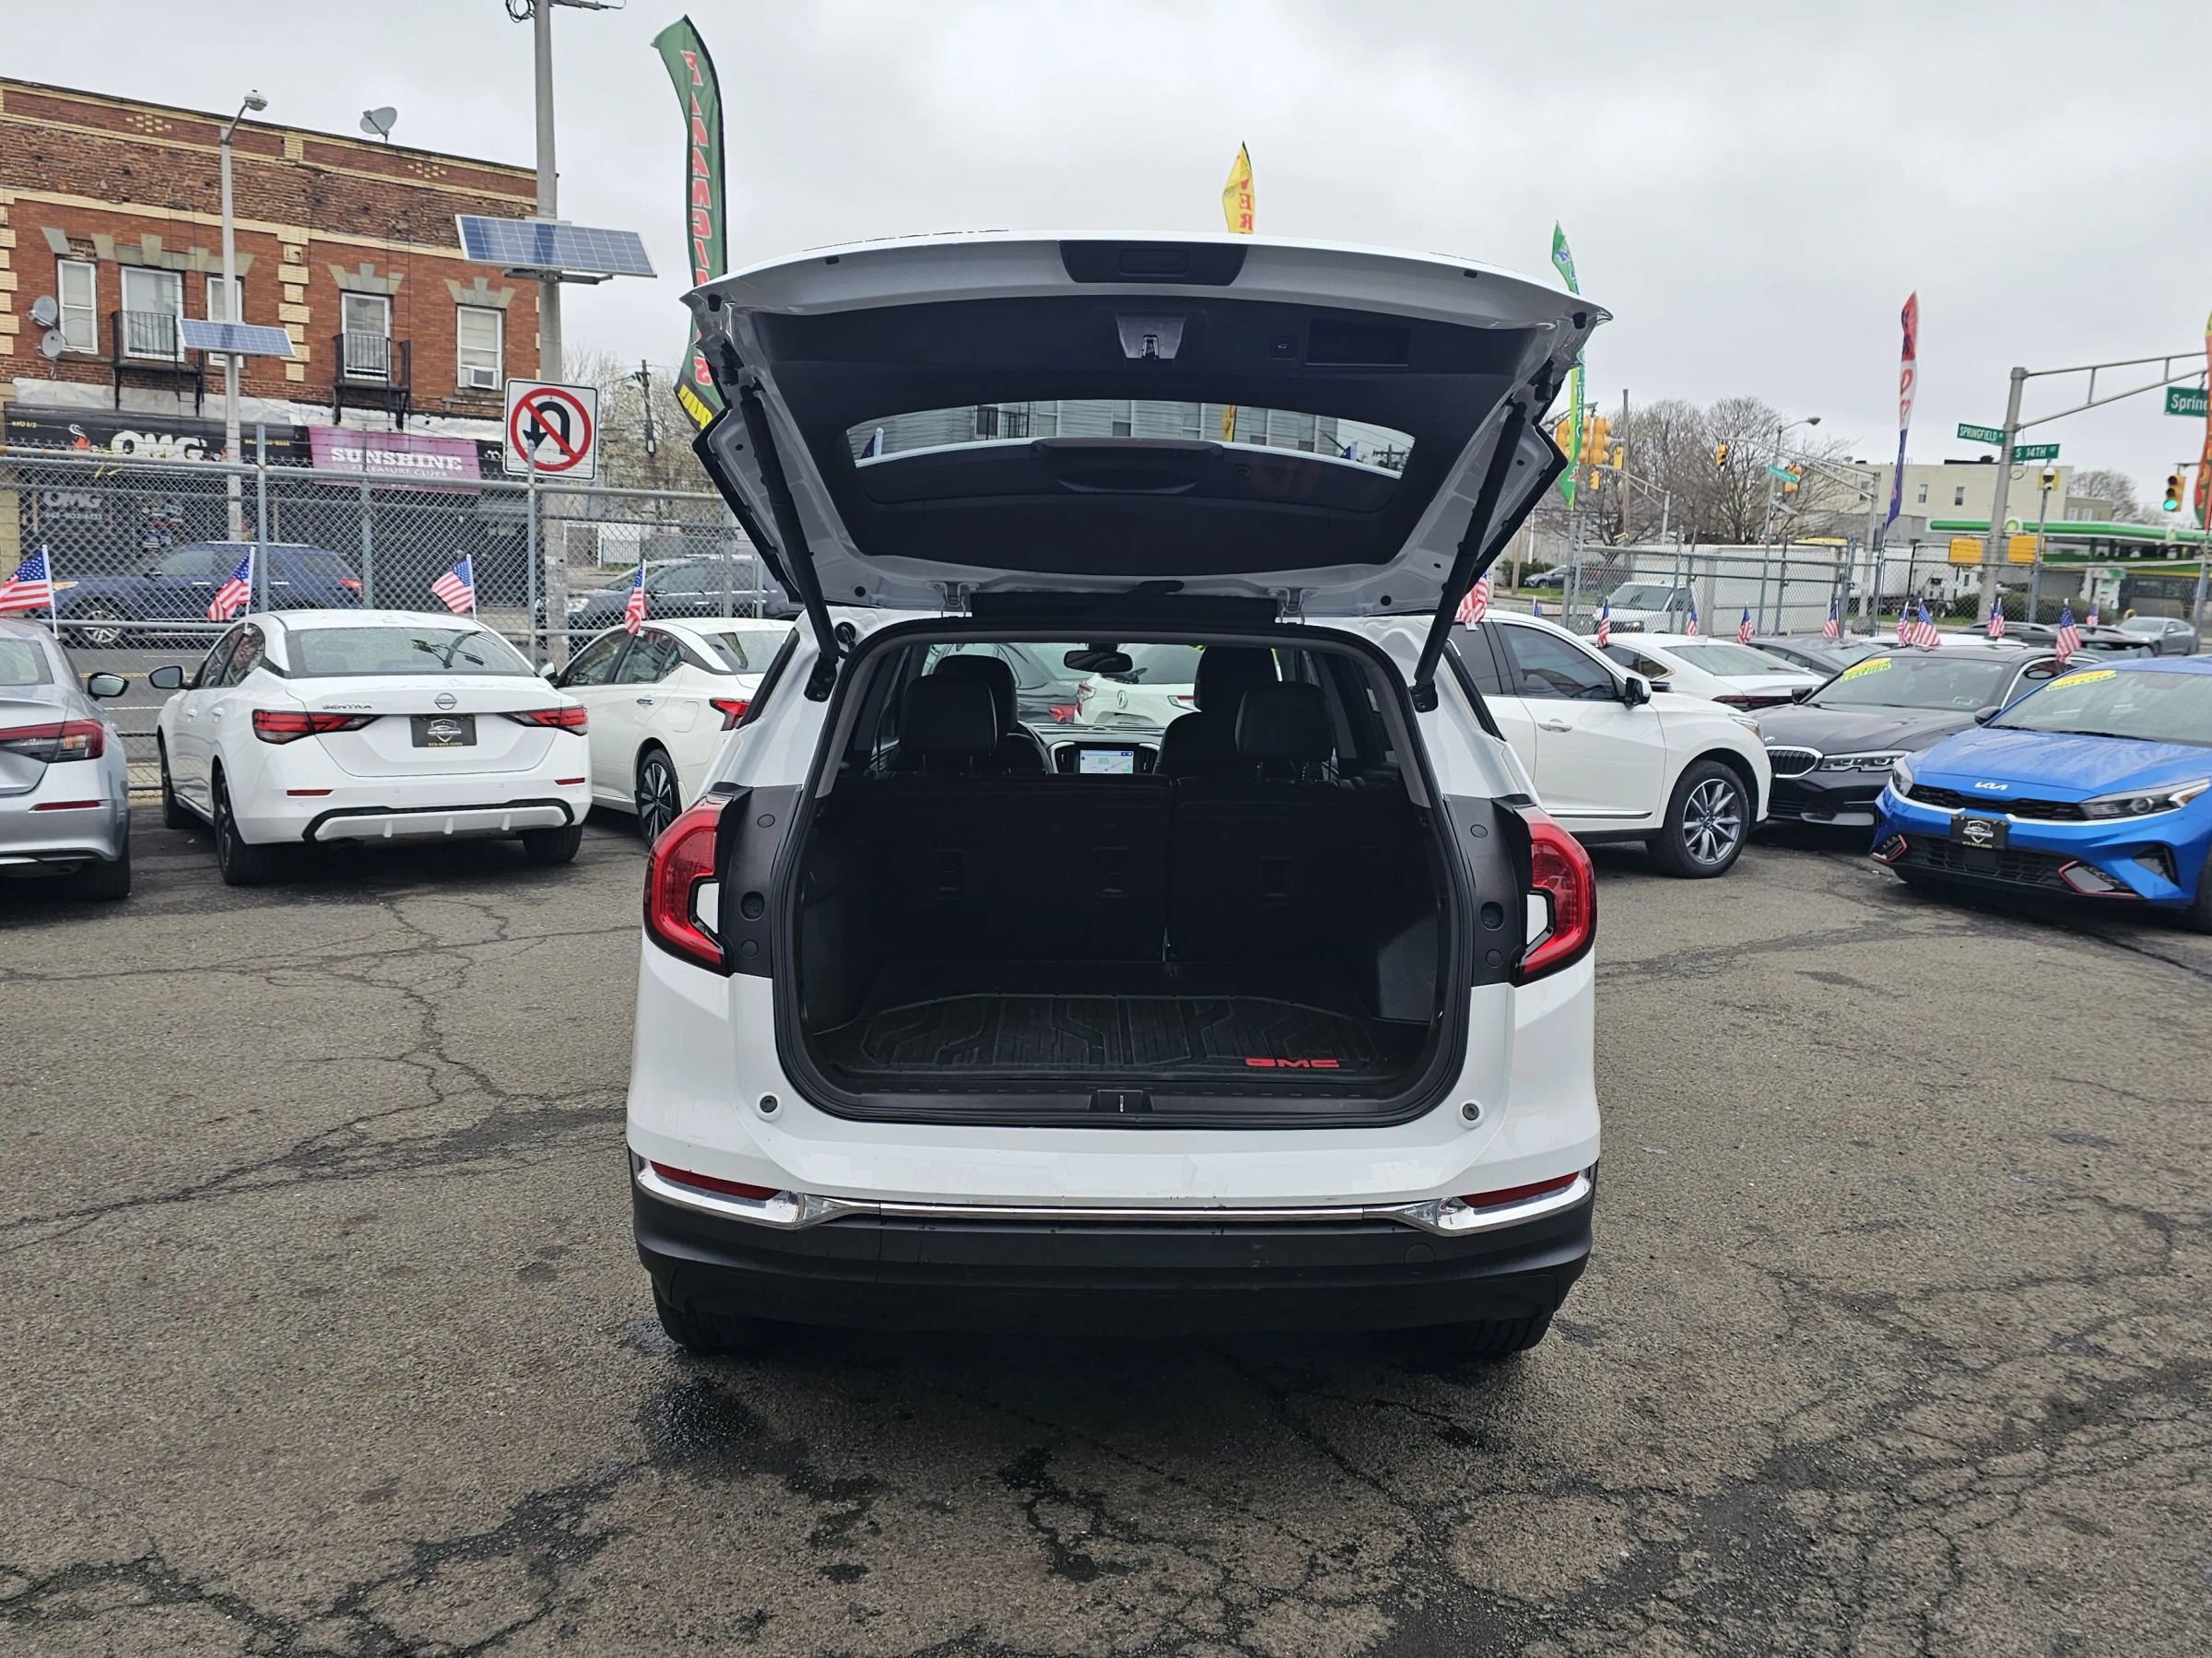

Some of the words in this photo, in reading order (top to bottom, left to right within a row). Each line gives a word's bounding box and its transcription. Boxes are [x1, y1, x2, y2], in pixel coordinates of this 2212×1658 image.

[1959, 425, 1998, 442] SPRINGFIELD
[331, 447, 464, 471] SUNSHINE
[2015, 448, 2022, 458] S
[2027, 446, 2047, 458] 14TH
[1245, 1058, 1340, 1069] GMC
